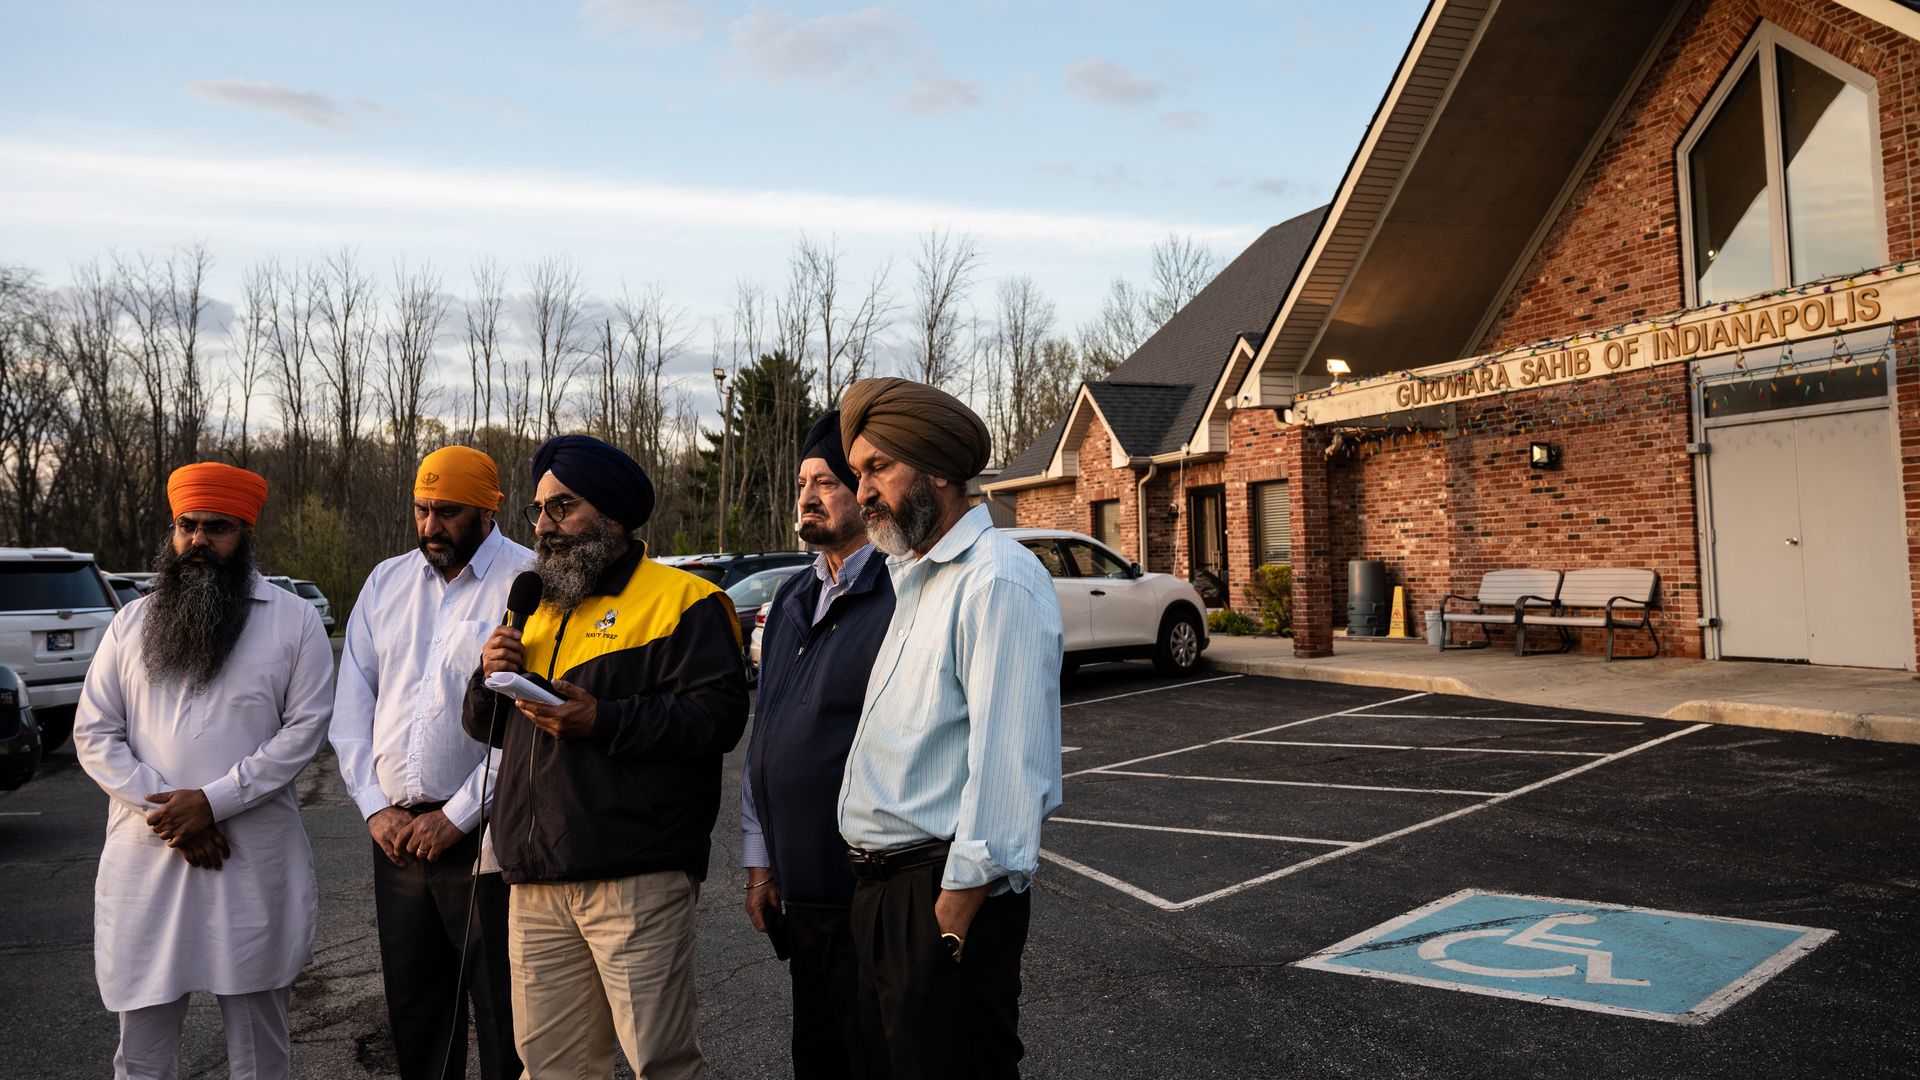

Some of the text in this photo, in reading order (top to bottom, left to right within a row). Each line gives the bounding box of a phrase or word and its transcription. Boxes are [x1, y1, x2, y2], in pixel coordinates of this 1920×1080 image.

[1396, 288, 1881, 407] GURDWARA SAHIB OF INDIANAPOLIS
